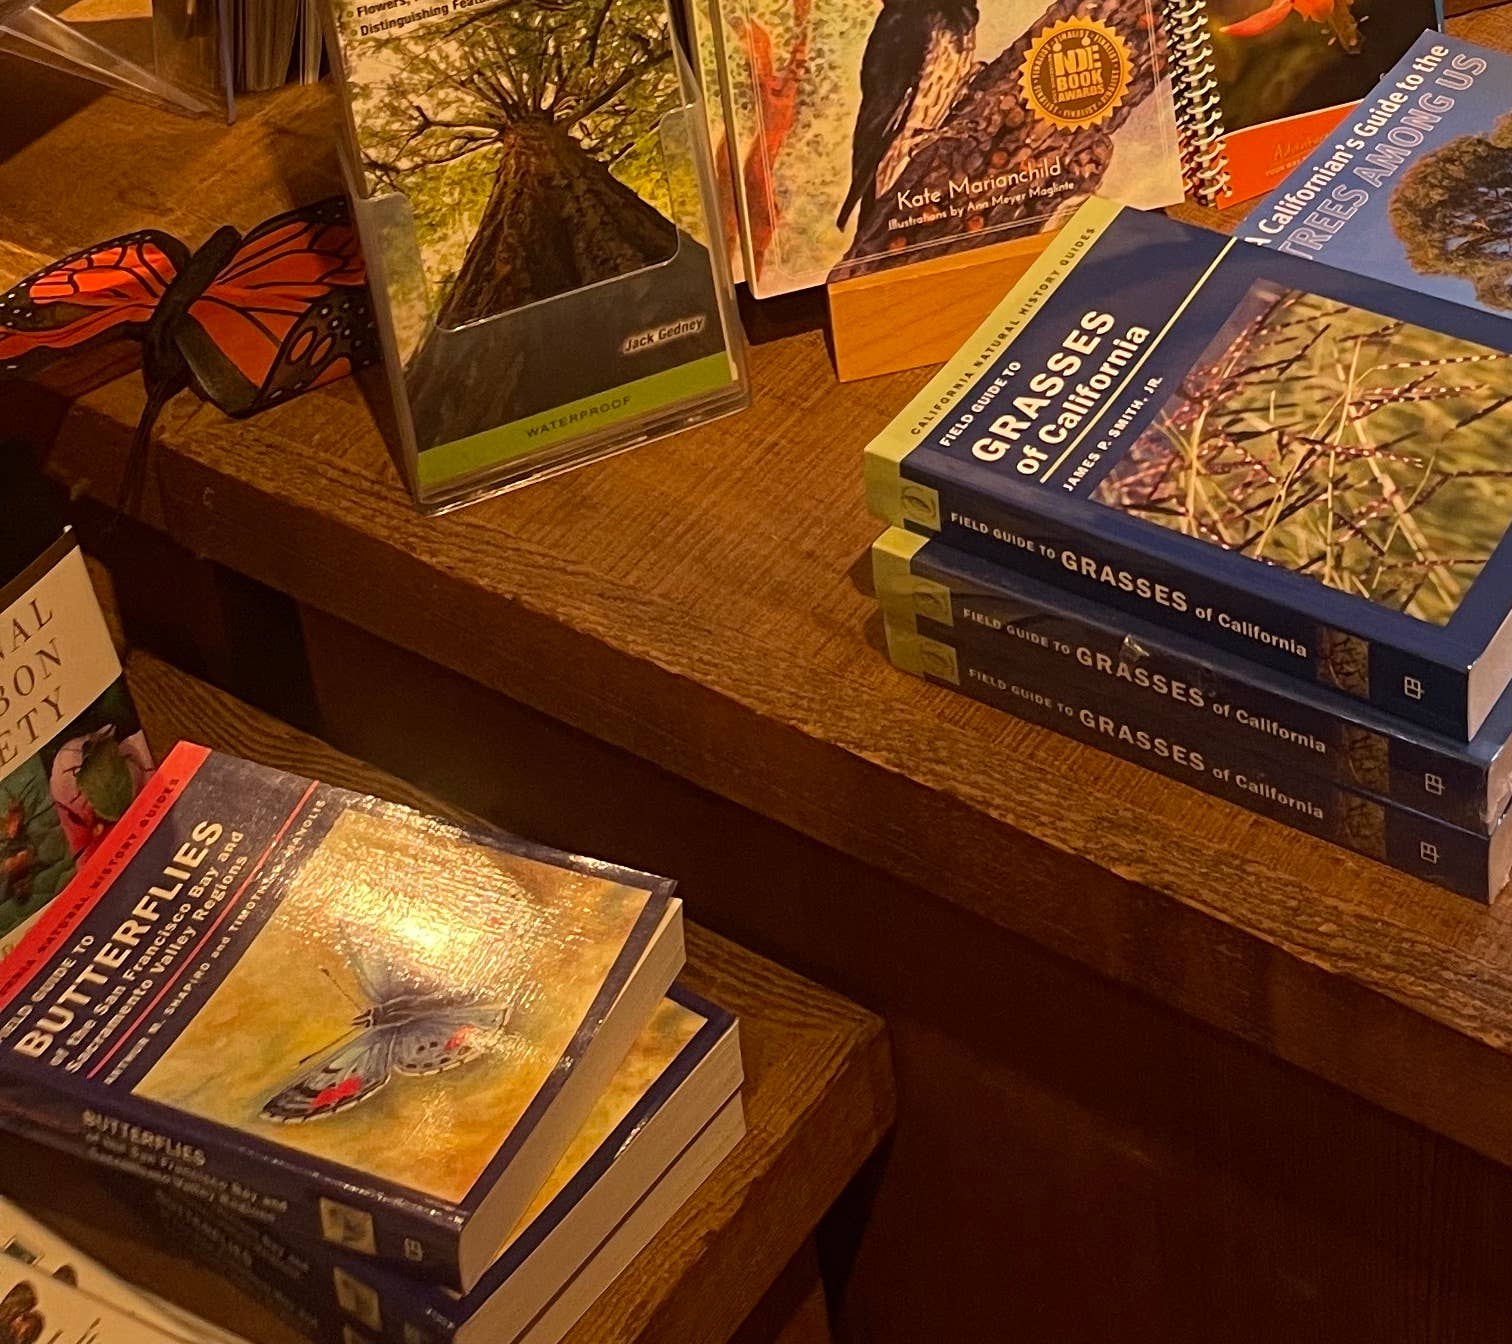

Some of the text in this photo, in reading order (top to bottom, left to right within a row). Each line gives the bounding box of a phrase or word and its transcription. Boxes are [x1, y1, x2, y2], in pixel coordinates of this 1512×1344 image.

[360, 4, 449, 37] Distinguishing
[897, 156, 1062, 210] Kate Marianchild
[1258, 138, 1365, 234] Californian's
[1353, 92, 1408, 137] Guide
[1395, 74, 1424, 92] to
[1413, 44, 1449, 73] the
[1278, 184, 1369, 260] TREES
[1353, 92, 1455, 188] AMONG
[1435, 53, 1487, 91] US
[625, 318, 704, 351] Jack Gedney
[971, 310, 1115, 462] GRASSES
[1016, 326, 1150, 475] of California
[527, 396, 632, 439] WATERPROOF
[13, 820, 223, 1058] BUTTERFLIES
